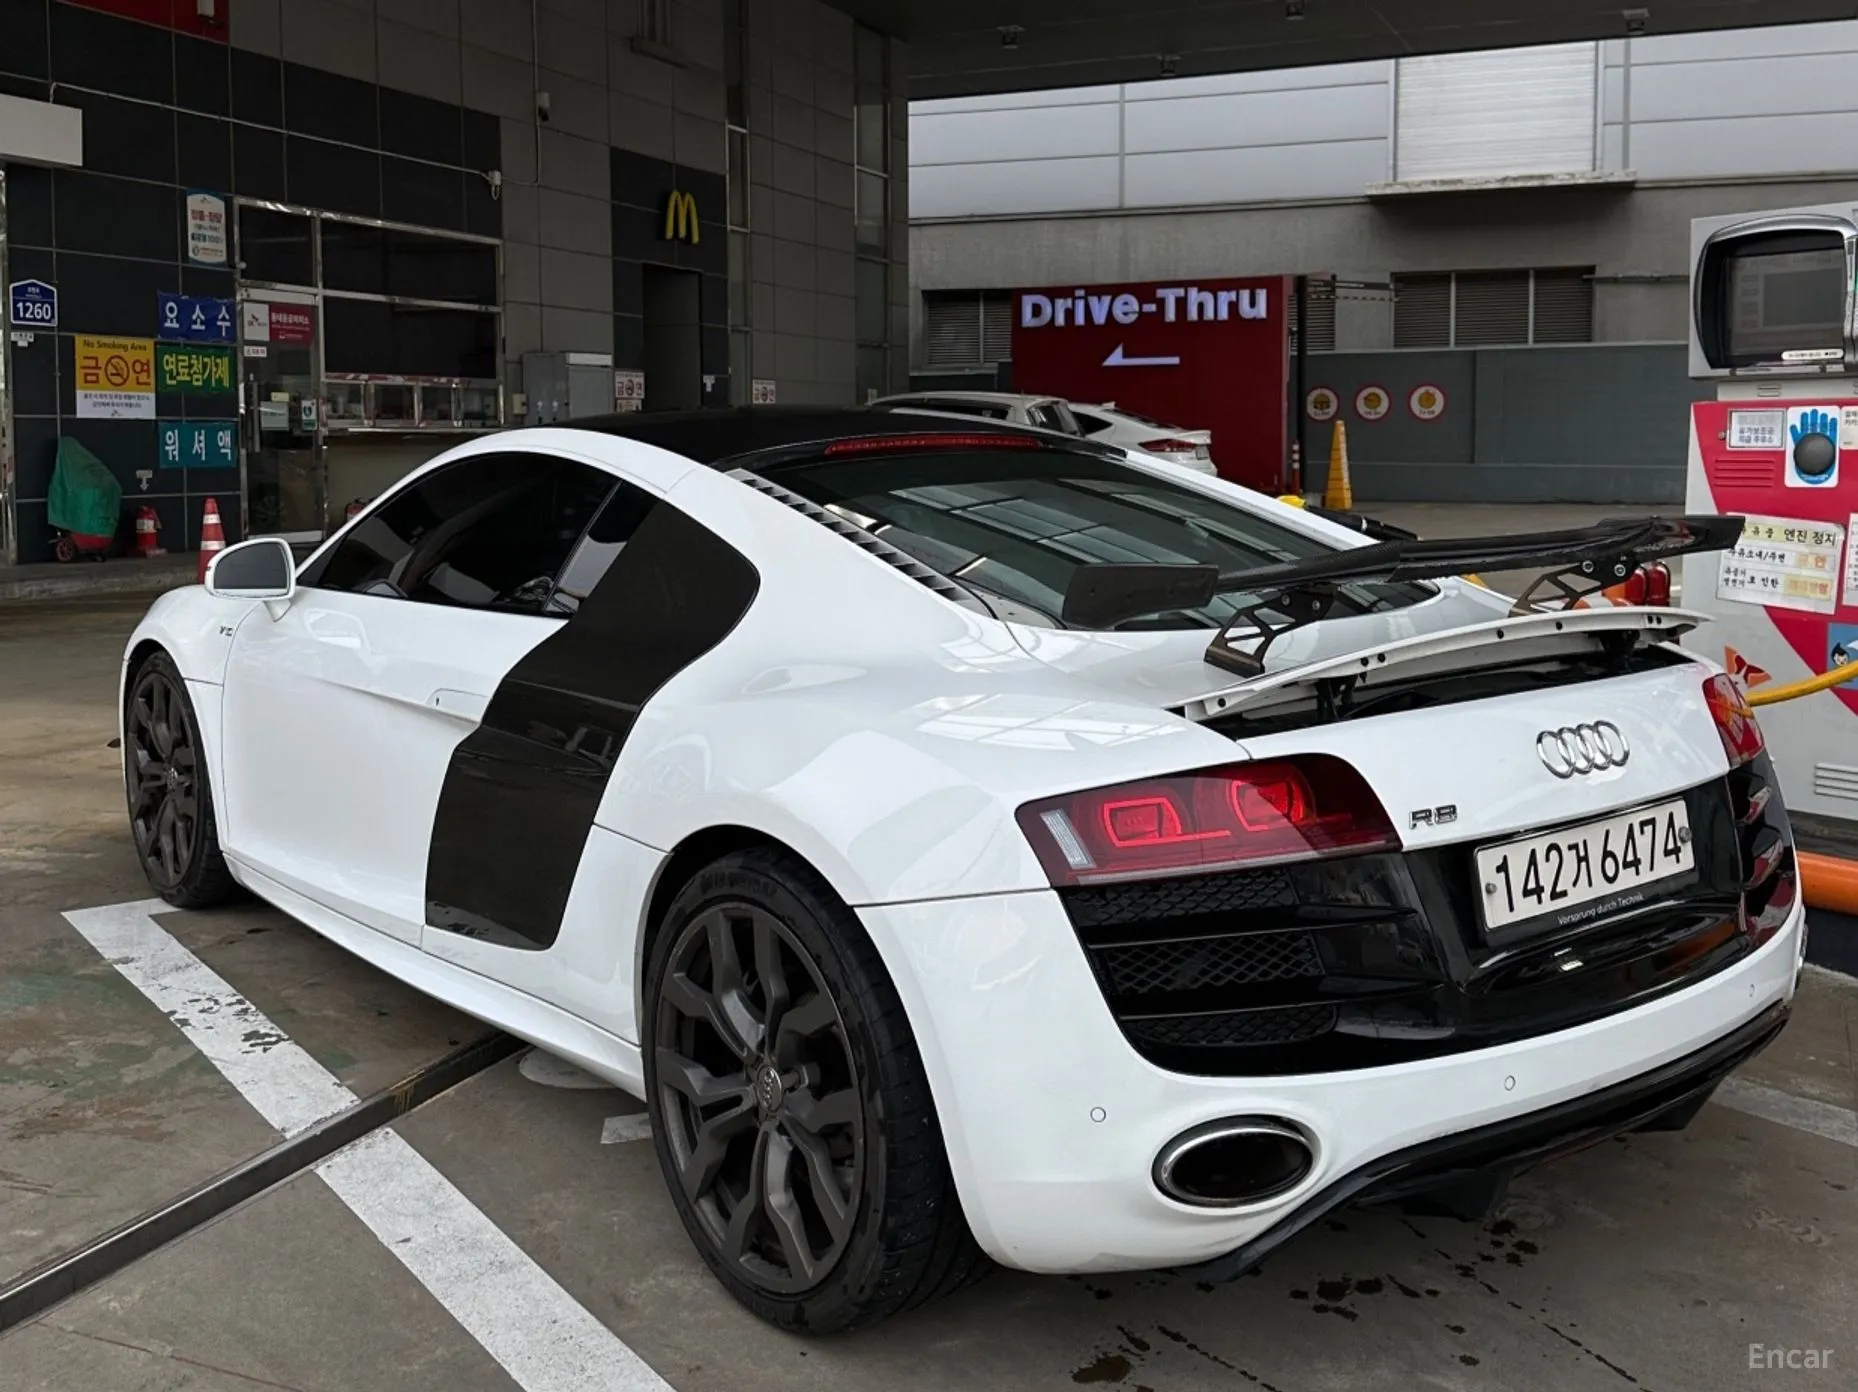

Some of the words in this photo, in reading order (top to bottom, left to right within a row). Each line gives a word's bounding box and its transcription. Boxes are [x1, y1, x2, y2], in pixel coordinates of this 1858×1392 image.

[16, 301, 51, 320] 1260
[1021, 287, 1268, 328] Drive-Thru
[97, 340, 128, 352] Smoking
[163, 353, 229, 388] 연료첨가제
[1784, 528, 1808, 543] 엔진
[1812, 530, 1836, 546] 정지
[1408, 804, 1457, 830] R8
[1557, 907, 1596, 925] Vorsprung
[1596, 901, 1617, 915] durch
[1617, 892, 1644, 908] Technik
